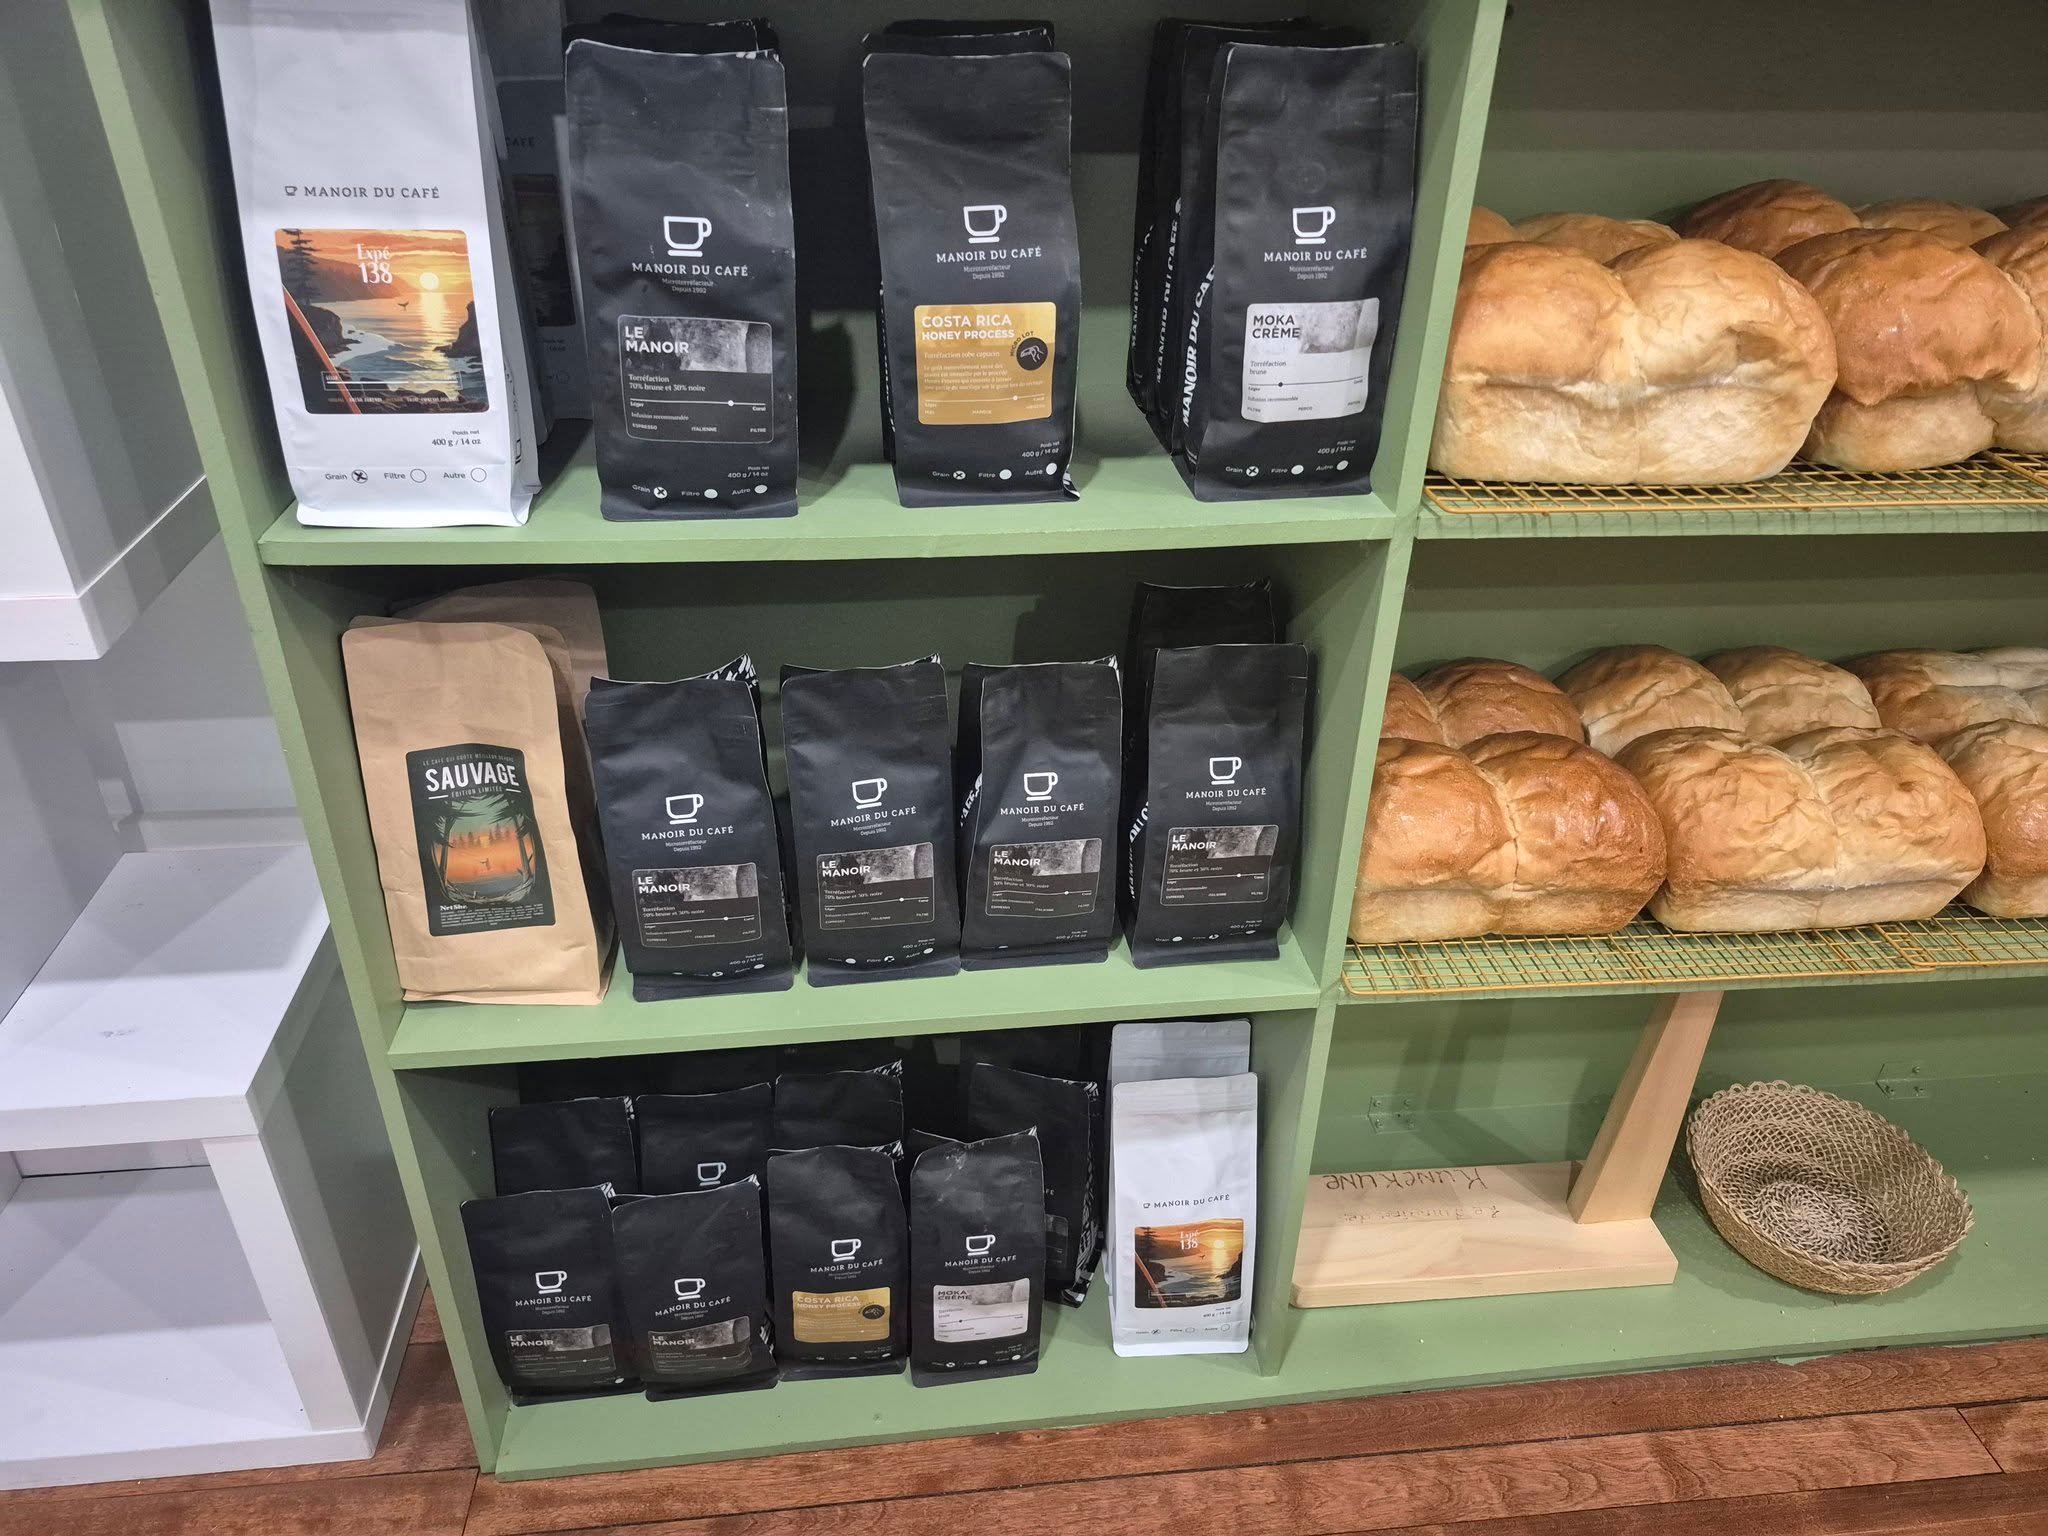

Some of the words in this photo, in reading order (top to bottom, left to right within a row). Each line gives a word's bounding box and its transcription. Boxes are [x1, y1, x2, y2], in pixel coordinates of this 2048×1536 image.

[304, 186, 368, 198] MANOIR
[374, 187, 395, 198] DU
[401, 186, 440, 199] CAFÉ
[357, 243, 392, 263] Expé
[936, 251, 986, 263] MANOIR
[990, 249, 1007, 260] DU
[1011, 247, 1042, 258] CAFÉ
[1264, 251, 1311, 262] MANOIR
[1315, 251, 1332, 260] DU
[1336, 247, 1367, 260] CAFÉ
[359, 262, 393, 284] 138
[632, 262, 687, 275] MANOIR
[692, 265, 710, 275] DU
[715, 265, 748, 276] CAFÉ
[921, 315, 972, 328] COSTA
[976, 314, 1012, 327] RICA
[1253, 314, 1295, 326] MOKA
[624, 326, 644, 338] LE
[1189, 311, 1200, 344] DU
[922, 331, 961, 340] HONEY
[964, 329, 1015, 339] PROCESS
[626, 340, 689, 353] MANOIR
[1010, 337, 1022, 356] MICRO
[1021, 331, 1034, 339] LOT
[628, 373, 670, 382] Torréfaction
[629, 382, 643, 390] 70%
[644, 383, 664, 391] brune
[1183, 345, 1197, 427] MANOIR
[432, 438, 447, 446] 400
[461, 438, 470, 446] 14
[325, 473, 348, 481] Grain
[384, 472, 406, 480] Filtre
[443, 472, 466, 480] Autre
[632, 484, 651, 493] Grain
[425, 762, 519, 792] SAUVAGE
[1185, 790, 1224, 799] MANOIR
[1227, 789, 1240, 797] DU
[1242, 787, 1267, 796] CAFÉ
[1000, 807, 1040, 815] MANOIR
[1060, 803, 1085, 811] CAFÉ
[830, 813, 871, 827] MANOIR
[874, 811, 888, 820] DU
[891, 805, 917, 817] CAFÉ
[641, 830, 685, 840] MANOIR
[689, 828, 704, 836] DU
[707, 825, 734, 835] CAFÉ
[1172, 834, 1186, 843] LE
[1171, 841, 1216, 851] MANOIR
[821, 860, 836, 869] LE
[994, 858, 1040, 866] MANOIR
[822, 866, 871, 877] MANOIR
[637, 876, 653, 885] LE
[638, 883, 690, 894] MANOIR
[1154, 1199, 1190, 1208] MANOIR
[1194, 1198, 1205, 1206] DU
[1208, 1194, 1230, 1202] CAFÉ
[1180, 1238, 1198, 1250] 138
[810, 1264, 845, 1273] MANOIR
[862, 1258, 883, 1268] CAFÉ
[945, 1259, 979, 1267] MANOIR
[515, 1297, 552, 1306] MANOIR
[655, 1303, 691, 1316] MANOIR
